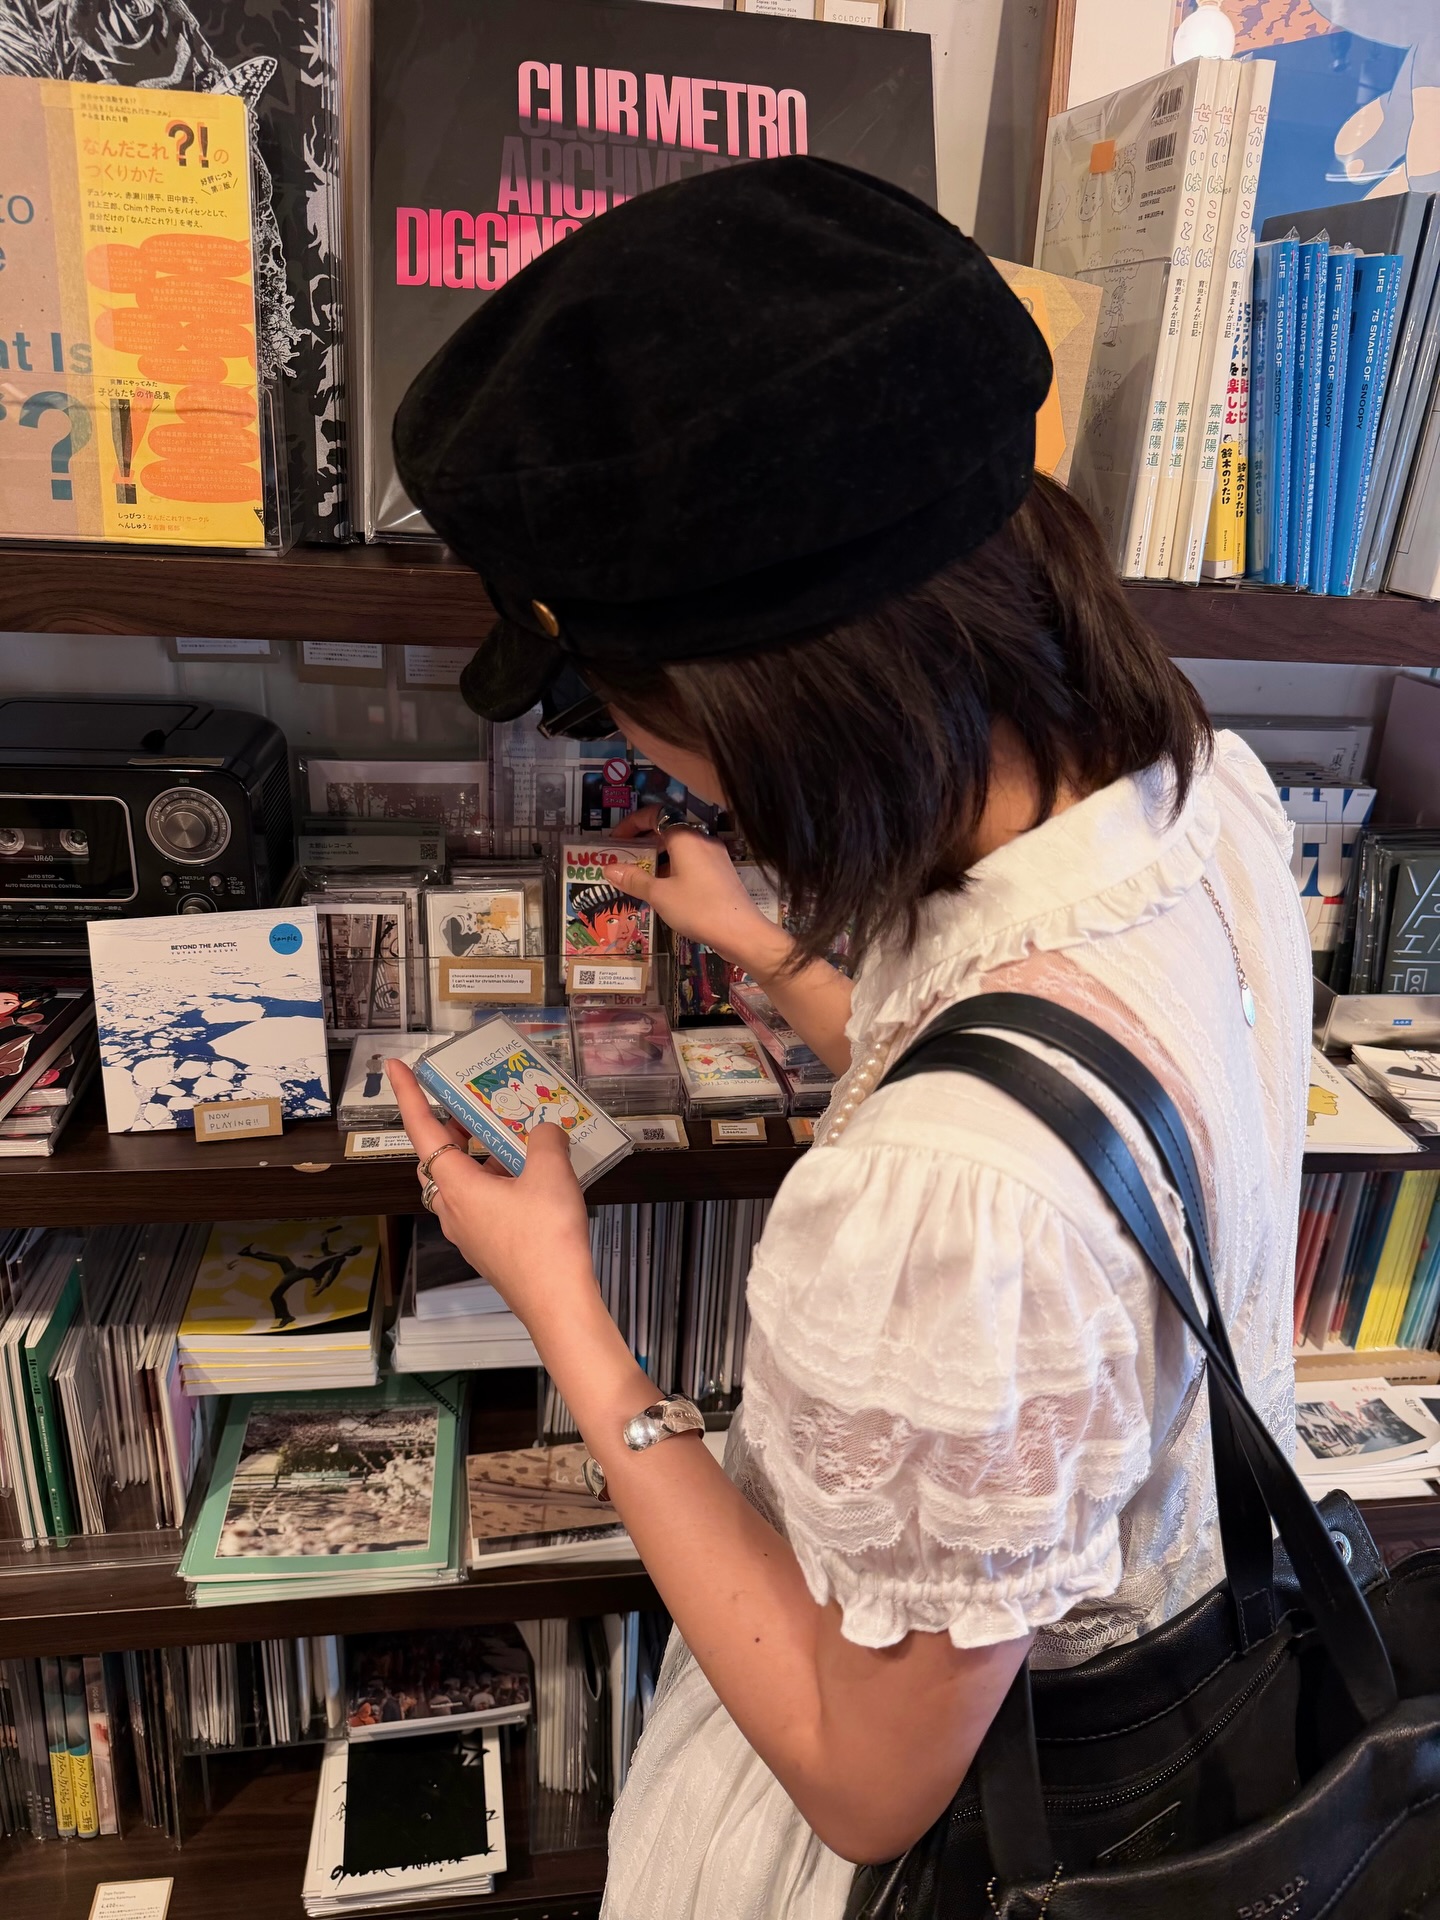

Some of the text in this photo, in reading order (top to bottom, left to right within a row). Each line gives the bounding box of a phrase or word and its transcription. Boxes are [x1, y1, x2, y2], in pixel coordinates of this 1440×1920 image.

[518, 61, 807, 159] CLUB METRO
[84, 164, 164, 185] つくりかた
[1302, 296, 1309, 310] 75
[1274, 253, 1286, 416] LIFE 75 SNAPS OF SNOOPY
[1299, 311, 1308, 352] SNAPS
[1324, 266, 1343, 429] LIFE 75 SNAPS OF SNOOPY
[1356, 267, 1386, 430] LIFE 75 SNAPS OF SNOOPY
[51, 332, 93, 374] Is
[1298, 354, 1305, 369] OF
[98, 388, 172, 401] 子どもたちの作品集
[1296, 370, 1304, 418] SNOOPY
[1220, 448, 1234, 506] 鈴木のりたけ
[1236, 462, 1247, 518] 鈴木のりたけ
[567, 850, 618, 867] LUCID
[272, 934, 298, 943] Sample
[456, 1038, 522, 1084] SUMMERTIME
[208, 1111, 232, 1121] NOW
[209, 1118, 260, 1132] PLAYING!!
[440, 1089, 522, 1172] SUMMERTIME
